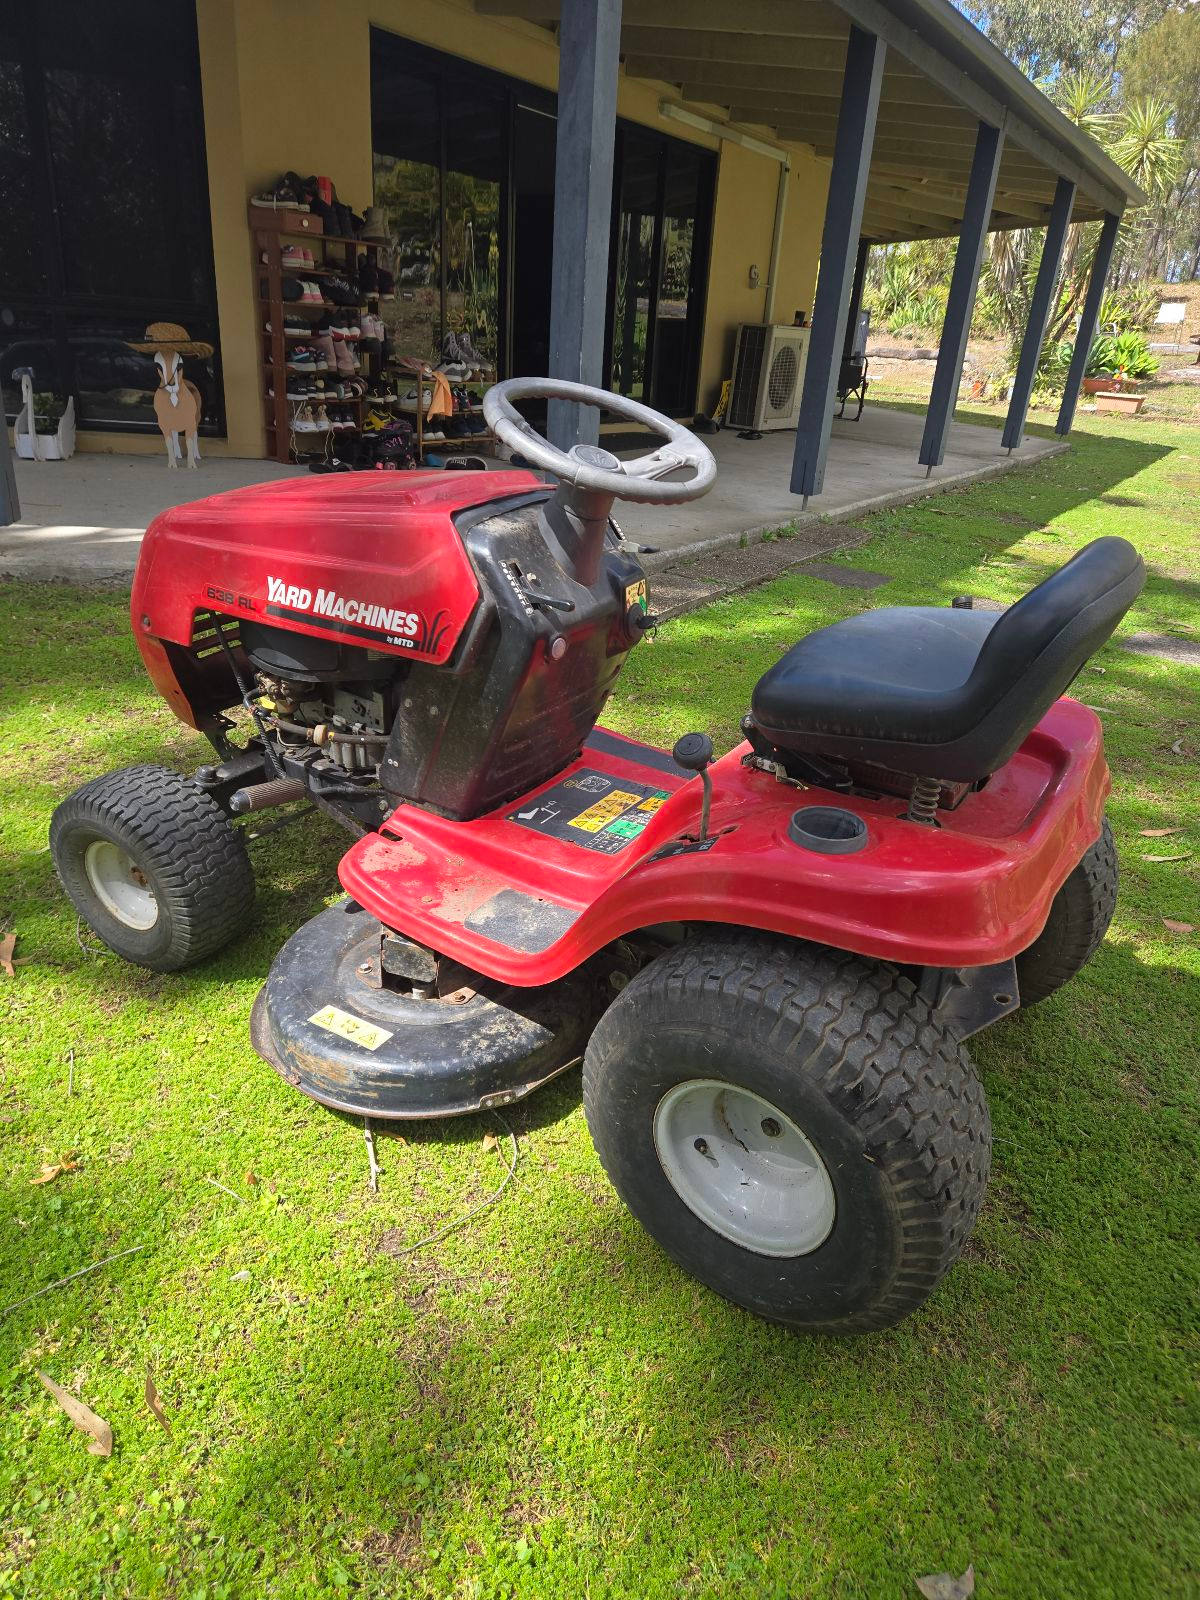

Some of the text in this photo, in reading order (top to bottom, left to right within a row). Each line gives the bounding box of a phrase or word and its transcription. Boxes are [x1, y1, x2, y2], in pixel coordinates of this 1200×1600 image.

[267, 576, 419, 635] YARD MACHINES
[394, 637, 414, 648] MTD
